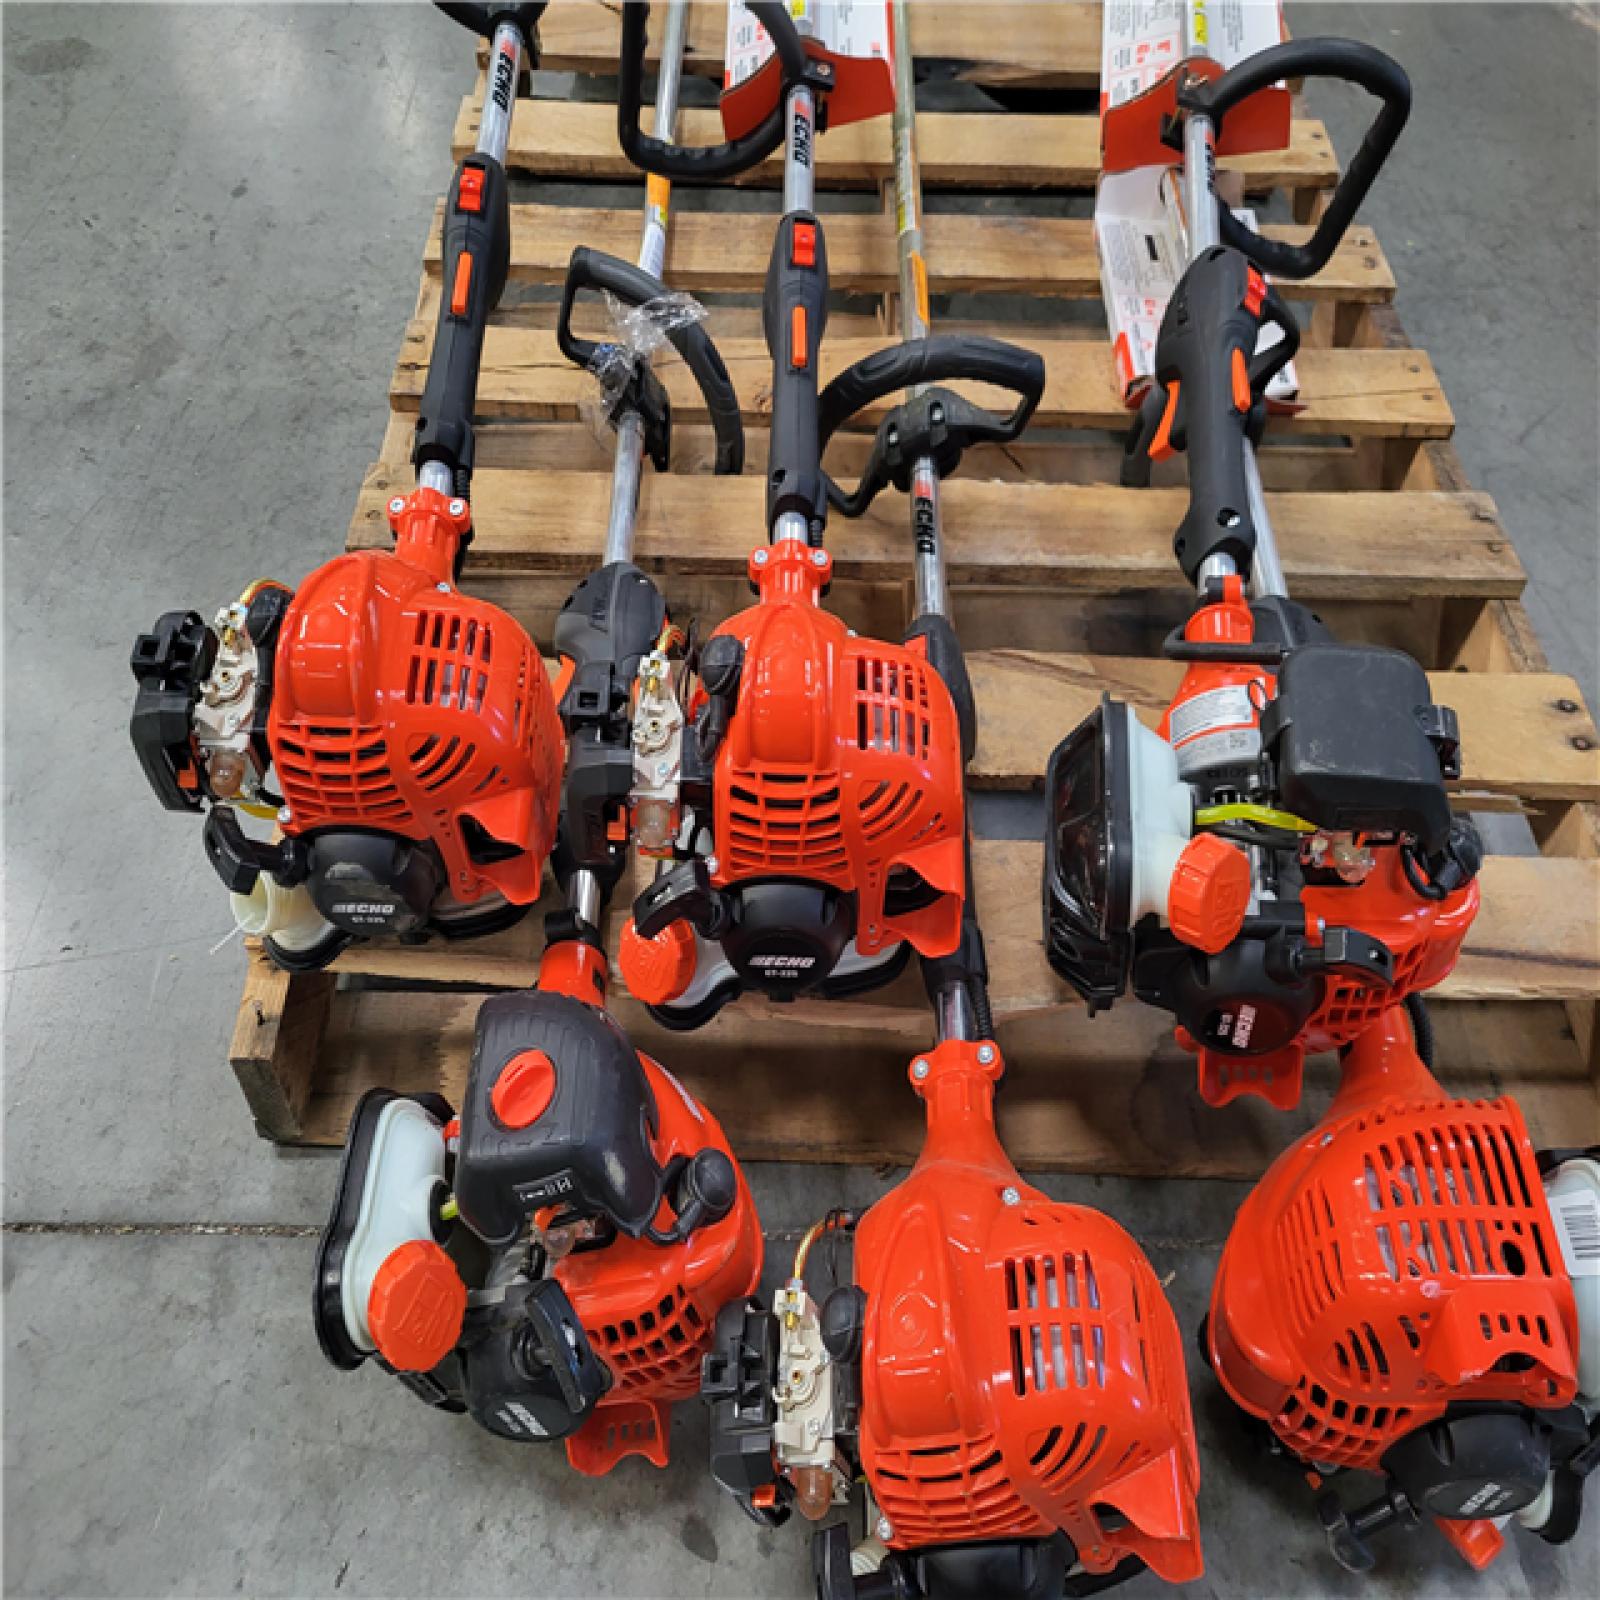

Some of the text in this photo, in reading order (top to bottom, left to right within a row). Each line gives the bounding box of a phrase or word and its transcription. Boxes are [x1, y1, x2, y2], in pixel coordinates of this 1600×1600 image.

[492, 51, 513, 113] ECHO
[794, 113, 810, 168] ECHO
[915, 496, 936, 555] ECHO
[344, 903, 396, 916] ECHO
[761, 953, 816, 968] ECHO
[1232, 1012, 1255, 1049] ECHO
[509, 1405, 549, 1436] ECHO
